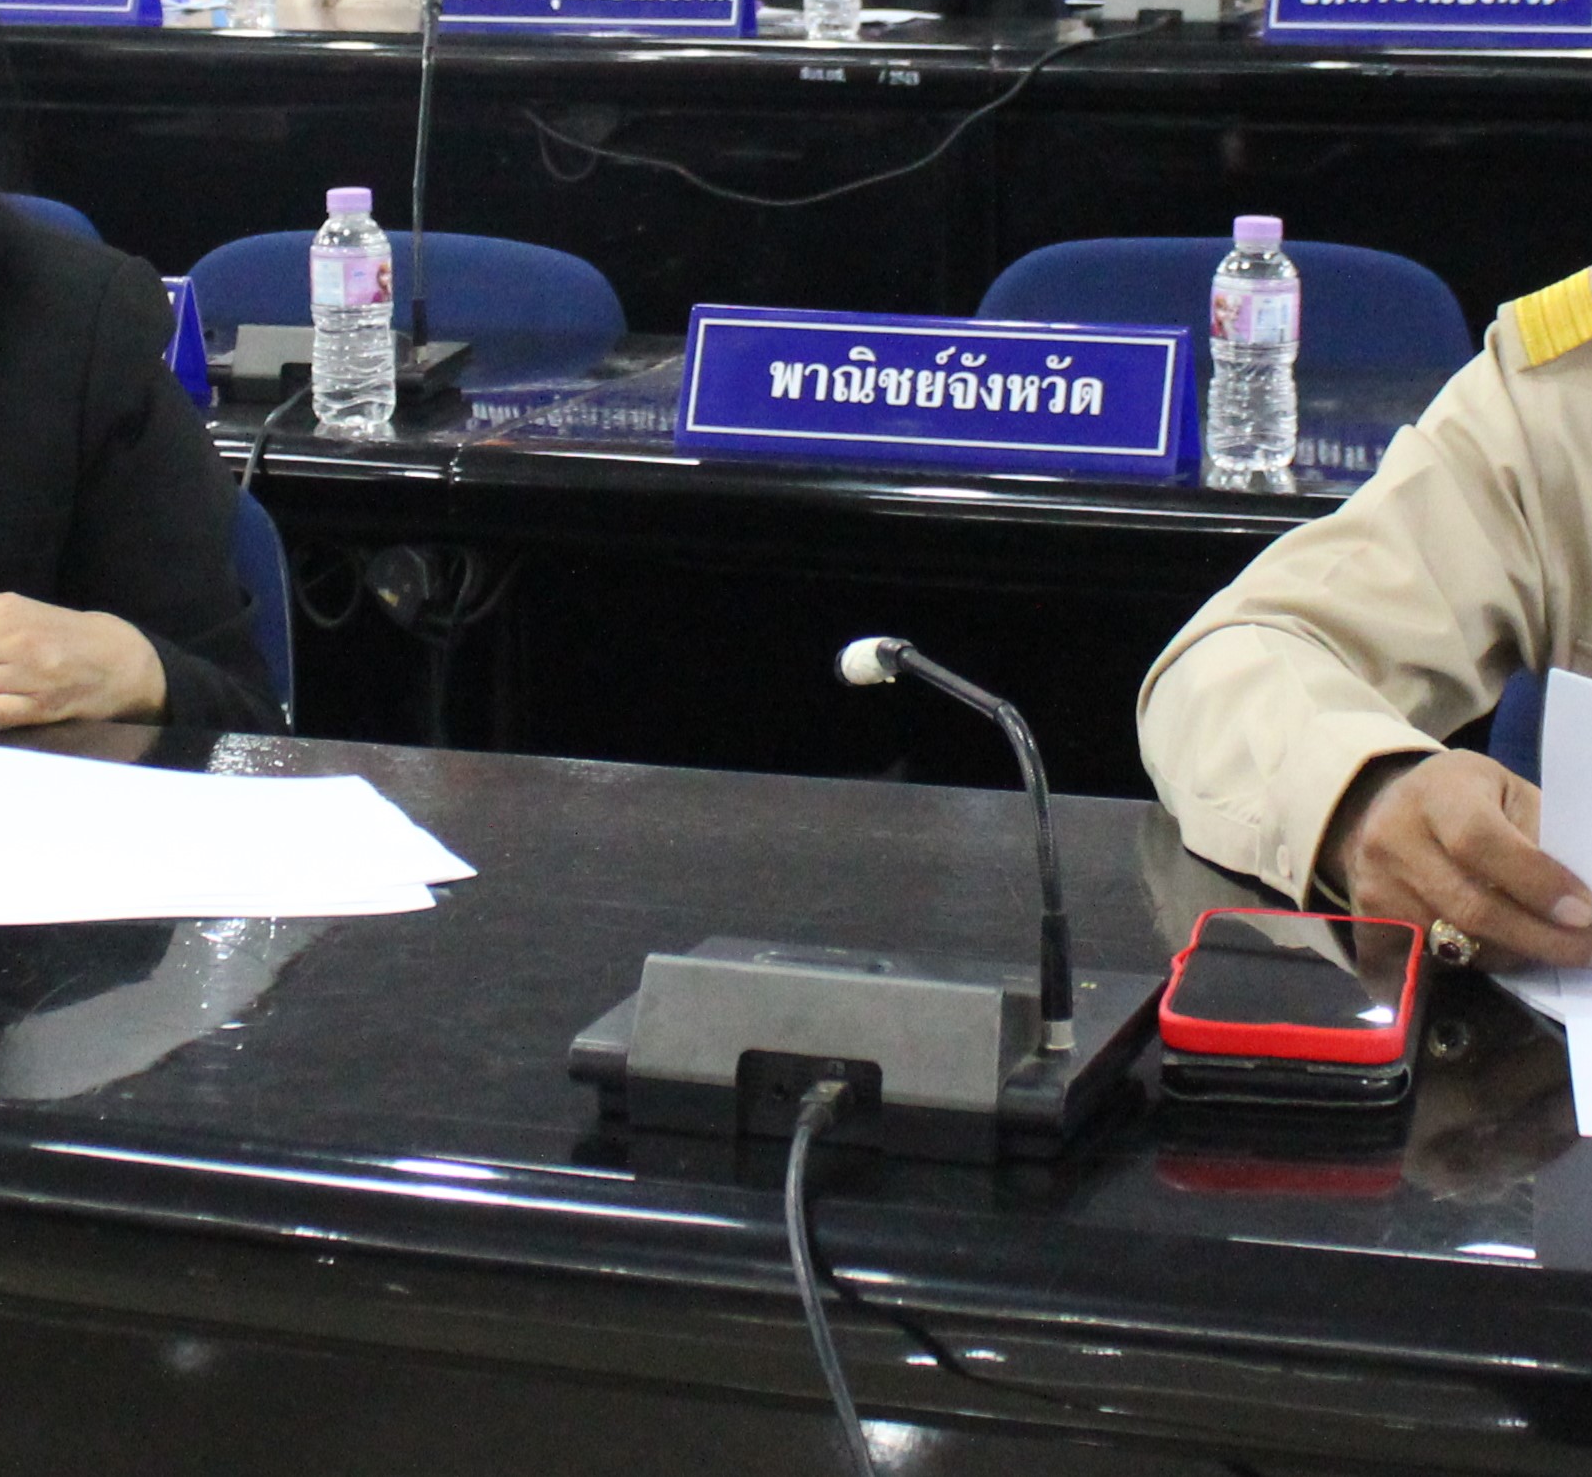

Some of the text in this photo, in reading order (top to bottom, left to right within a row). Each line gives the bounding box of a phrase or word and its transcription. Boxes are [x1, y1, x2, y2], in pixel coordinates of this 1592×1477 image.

[769, 345, 1104, 416] พาณิชย์จังหวัด
